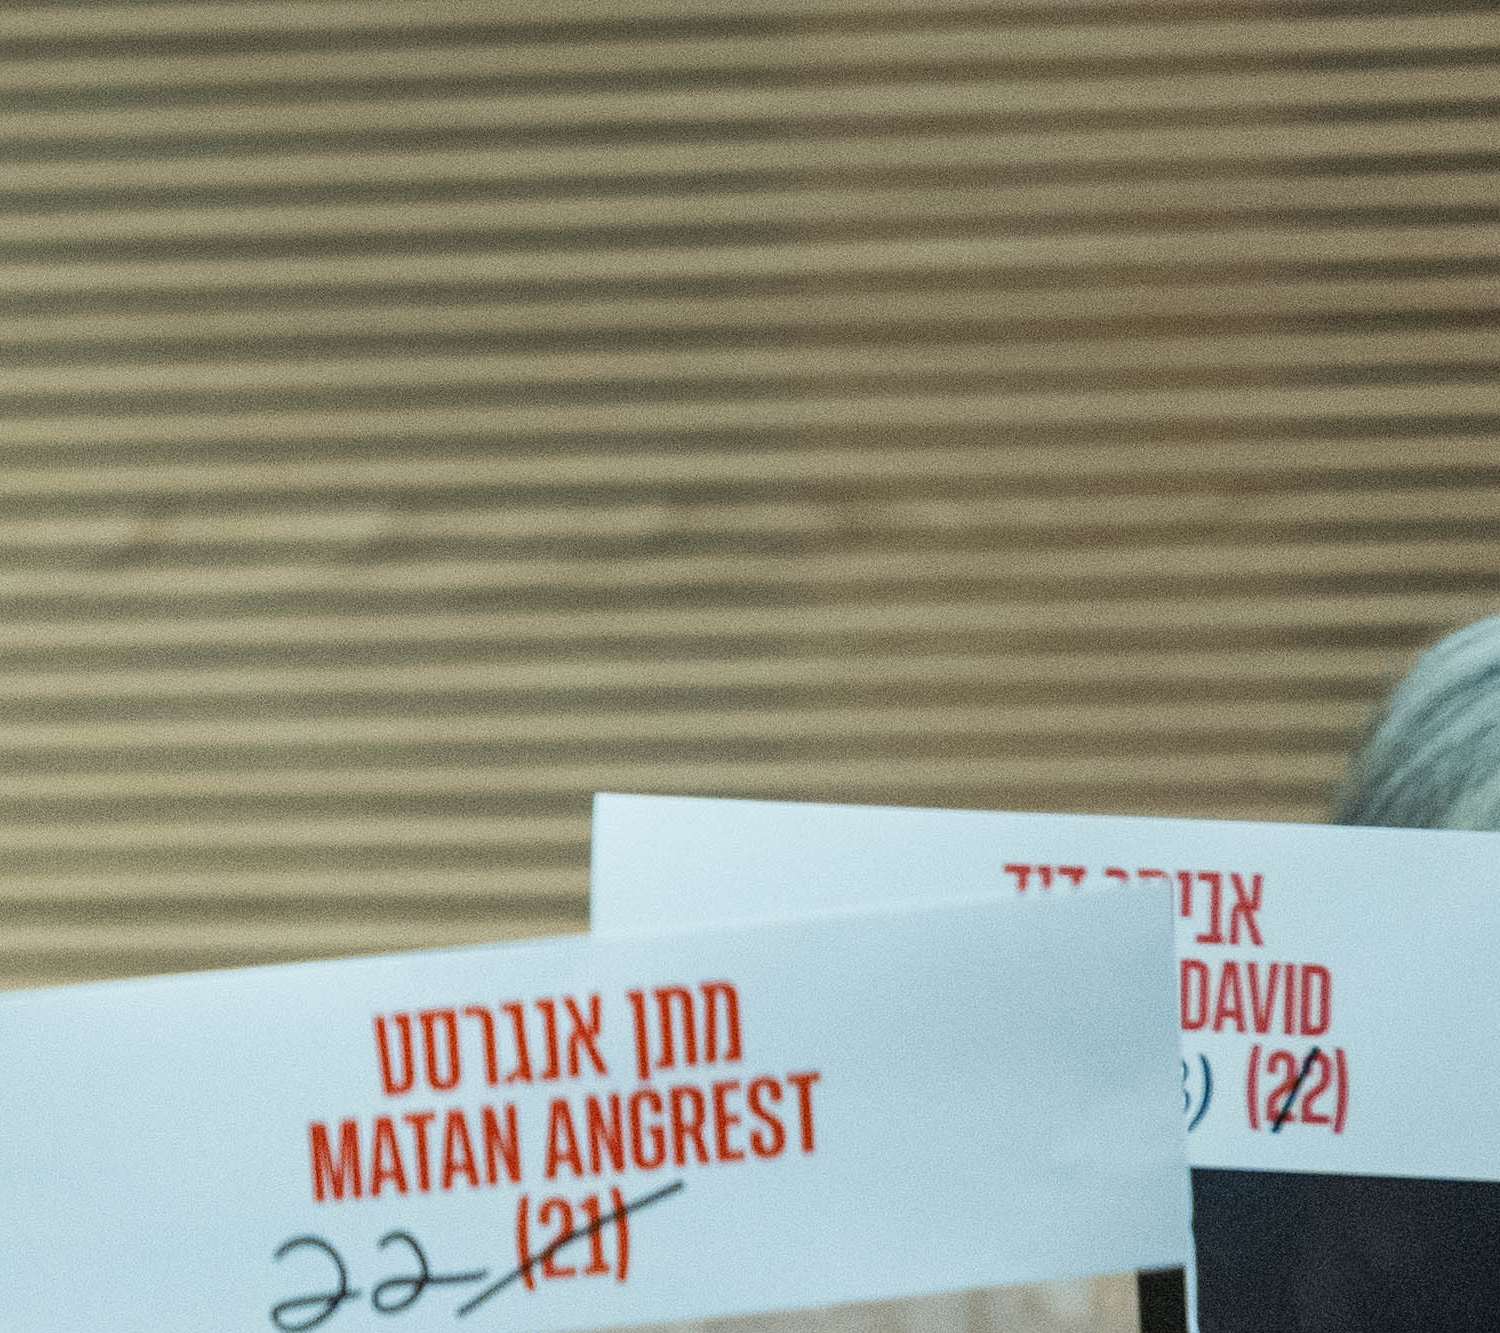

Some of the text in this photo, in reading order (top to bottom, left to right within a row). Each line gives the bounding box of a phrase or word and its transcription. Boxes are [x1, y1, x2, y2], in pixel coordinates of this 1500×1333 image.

[1105, 869, 1264, 946] אבי
[373, 981, 743, 1097] מתן אנגרסט
[1180, 959, 1331, 1036] DAVID
[308, 1071, 821, 1203] MATAN ANGREST
